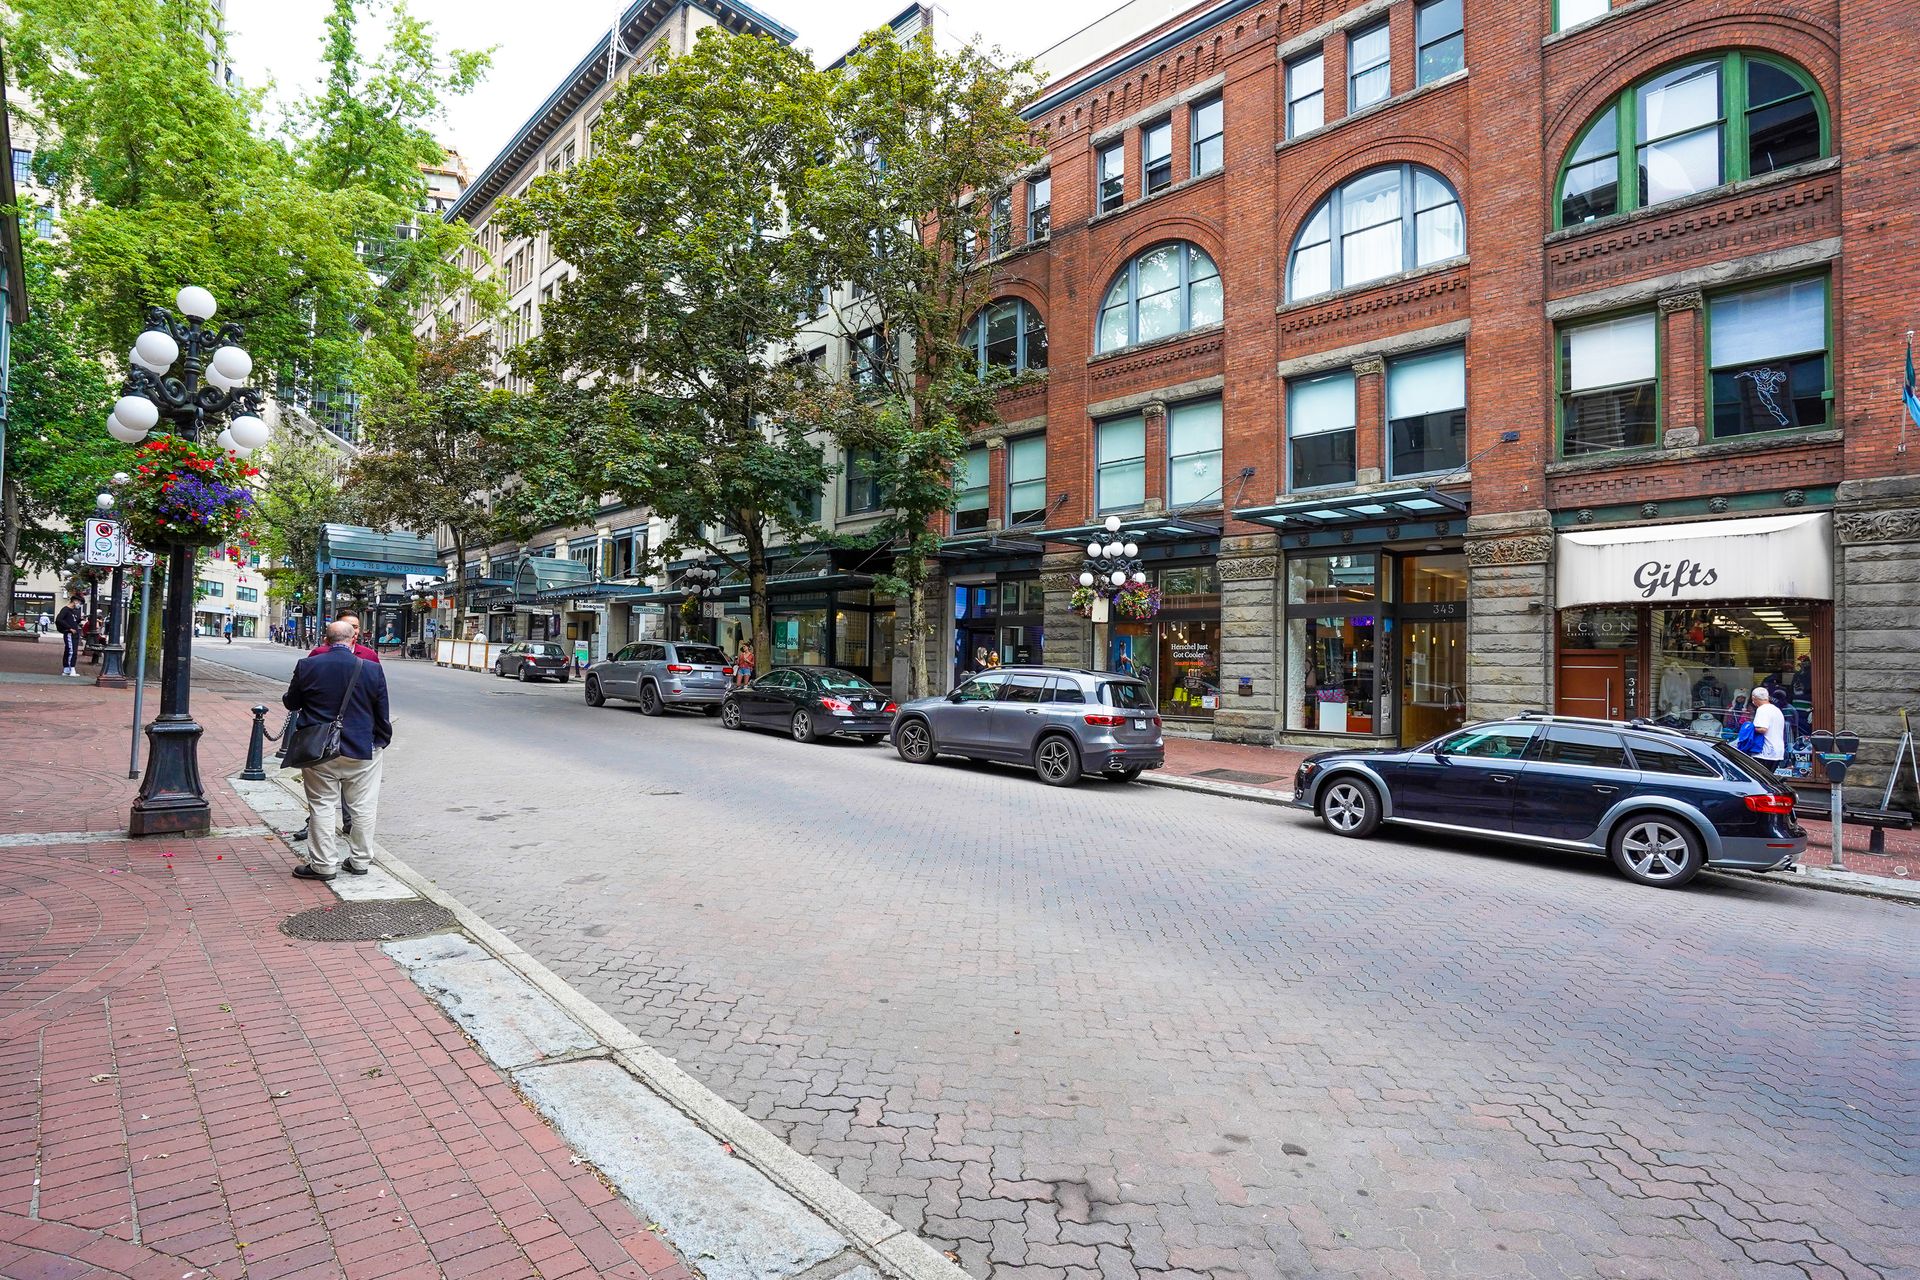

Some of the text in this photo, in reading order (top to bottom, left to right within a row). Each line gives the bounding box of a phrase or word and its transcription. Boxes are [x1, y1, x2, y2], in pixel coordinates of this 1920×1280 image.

[386, 564, 430, 574] LANDING
[1633, 559, 1718, 598] Gifts
[1433, 604, 1455, 615] 345
[1171, 643, 1209, 652] Herschel Just
[1173, 651, 1184, 659] Got
[1628, 677, 1636, 708] 341
